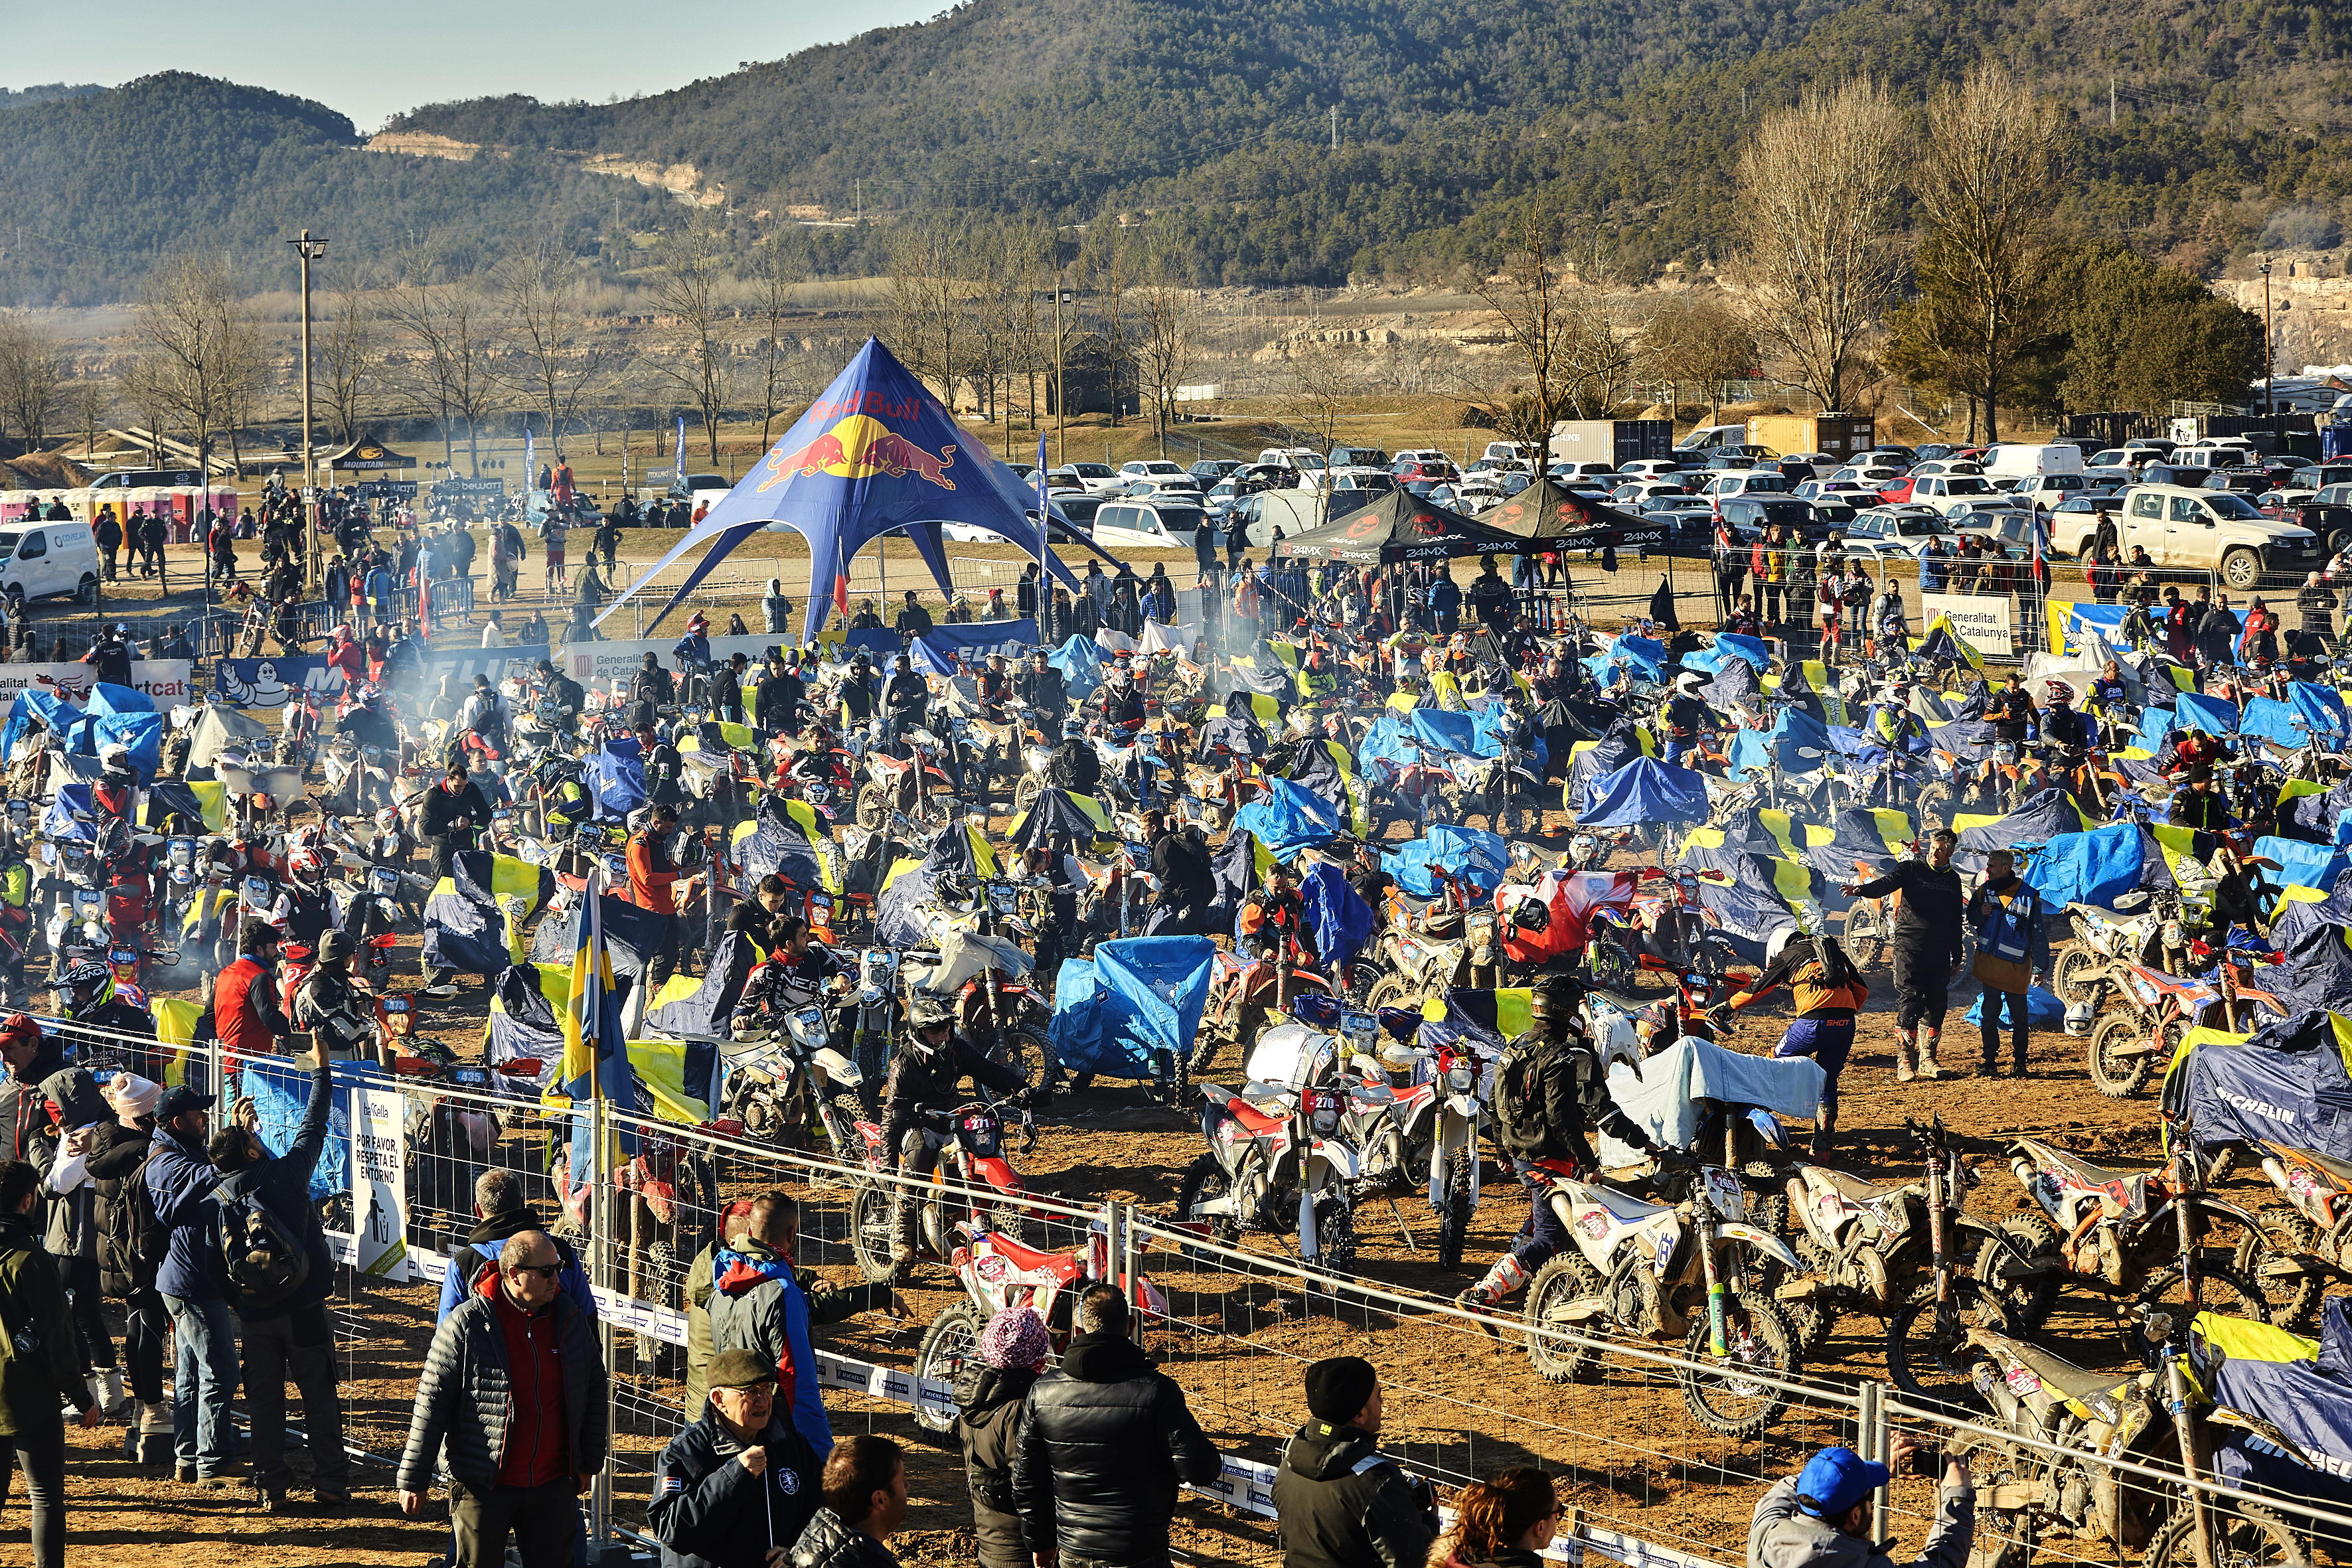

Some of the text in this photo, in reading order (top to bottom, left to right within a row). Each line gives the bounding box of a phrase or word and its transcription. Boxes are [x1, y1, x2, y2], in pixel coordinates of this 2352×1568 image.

[809, 390, 861, 424] Red
[866, 391, 921, 421] Bull
[1566, 522, 1611, 533] 24MX
[1326, 536, 1362, 546] 24MX
[1419, 533, 1466, 544] 24MX
[1556, 535, 1595, 548] 24MX
[1624, 530, 1662, 542] 24MX
[1293, 545, 1321, 556] 24MX
[1406, 546, 1449, 558] 24MX
[1476, 541, 1518, 552] 24MX
[1341, 550, 1372, 560] 24MX
[1945, 610, 1996, 624] Generalitat
[1960, 625, 2008, 640] Catalunya
[596, 655, 645, 665] Generalit
[597, 666, 609, 676] de
[380, 871, 394, 881] 546
[82, 893, 97, 902] 548
[118, 952, 131, 961] 511
[872, 954, 888, 963] 470
[1691, 976, 1707, 986] 432
[389, 1000, 404, 1010] 473
[1354, 1018, 1371, 1028] 430
[461, 1071, 481, 1082] 435
[1316, 1097, 1334, 1109] 270
[2216, 1086, 2296, 1125] MICHELIN
[971, 1119, 989, 1131] 271
[356, 1135, 398, 1154] POR FAVOR,
[356, 1149, 399, 1169] RESPETA EL
[360, 1166, 394, 1184] ENTORNO
[1717, 1176, 1735, 1190] 265
[1714, 1298, 1725, 1342] MOTOREX
[842, 1372, 866, 1382] MICHELIN
[886, 1381, 908, 1392] MICHELIN
[2009, 1373, 2036, 1393] 260
[926, 1391, 951, 1401] MICHELIN
[1227, 1465, 1253, 1478] MICHELIN
[1650, 1555, 1679, 1567] MICHELIN
